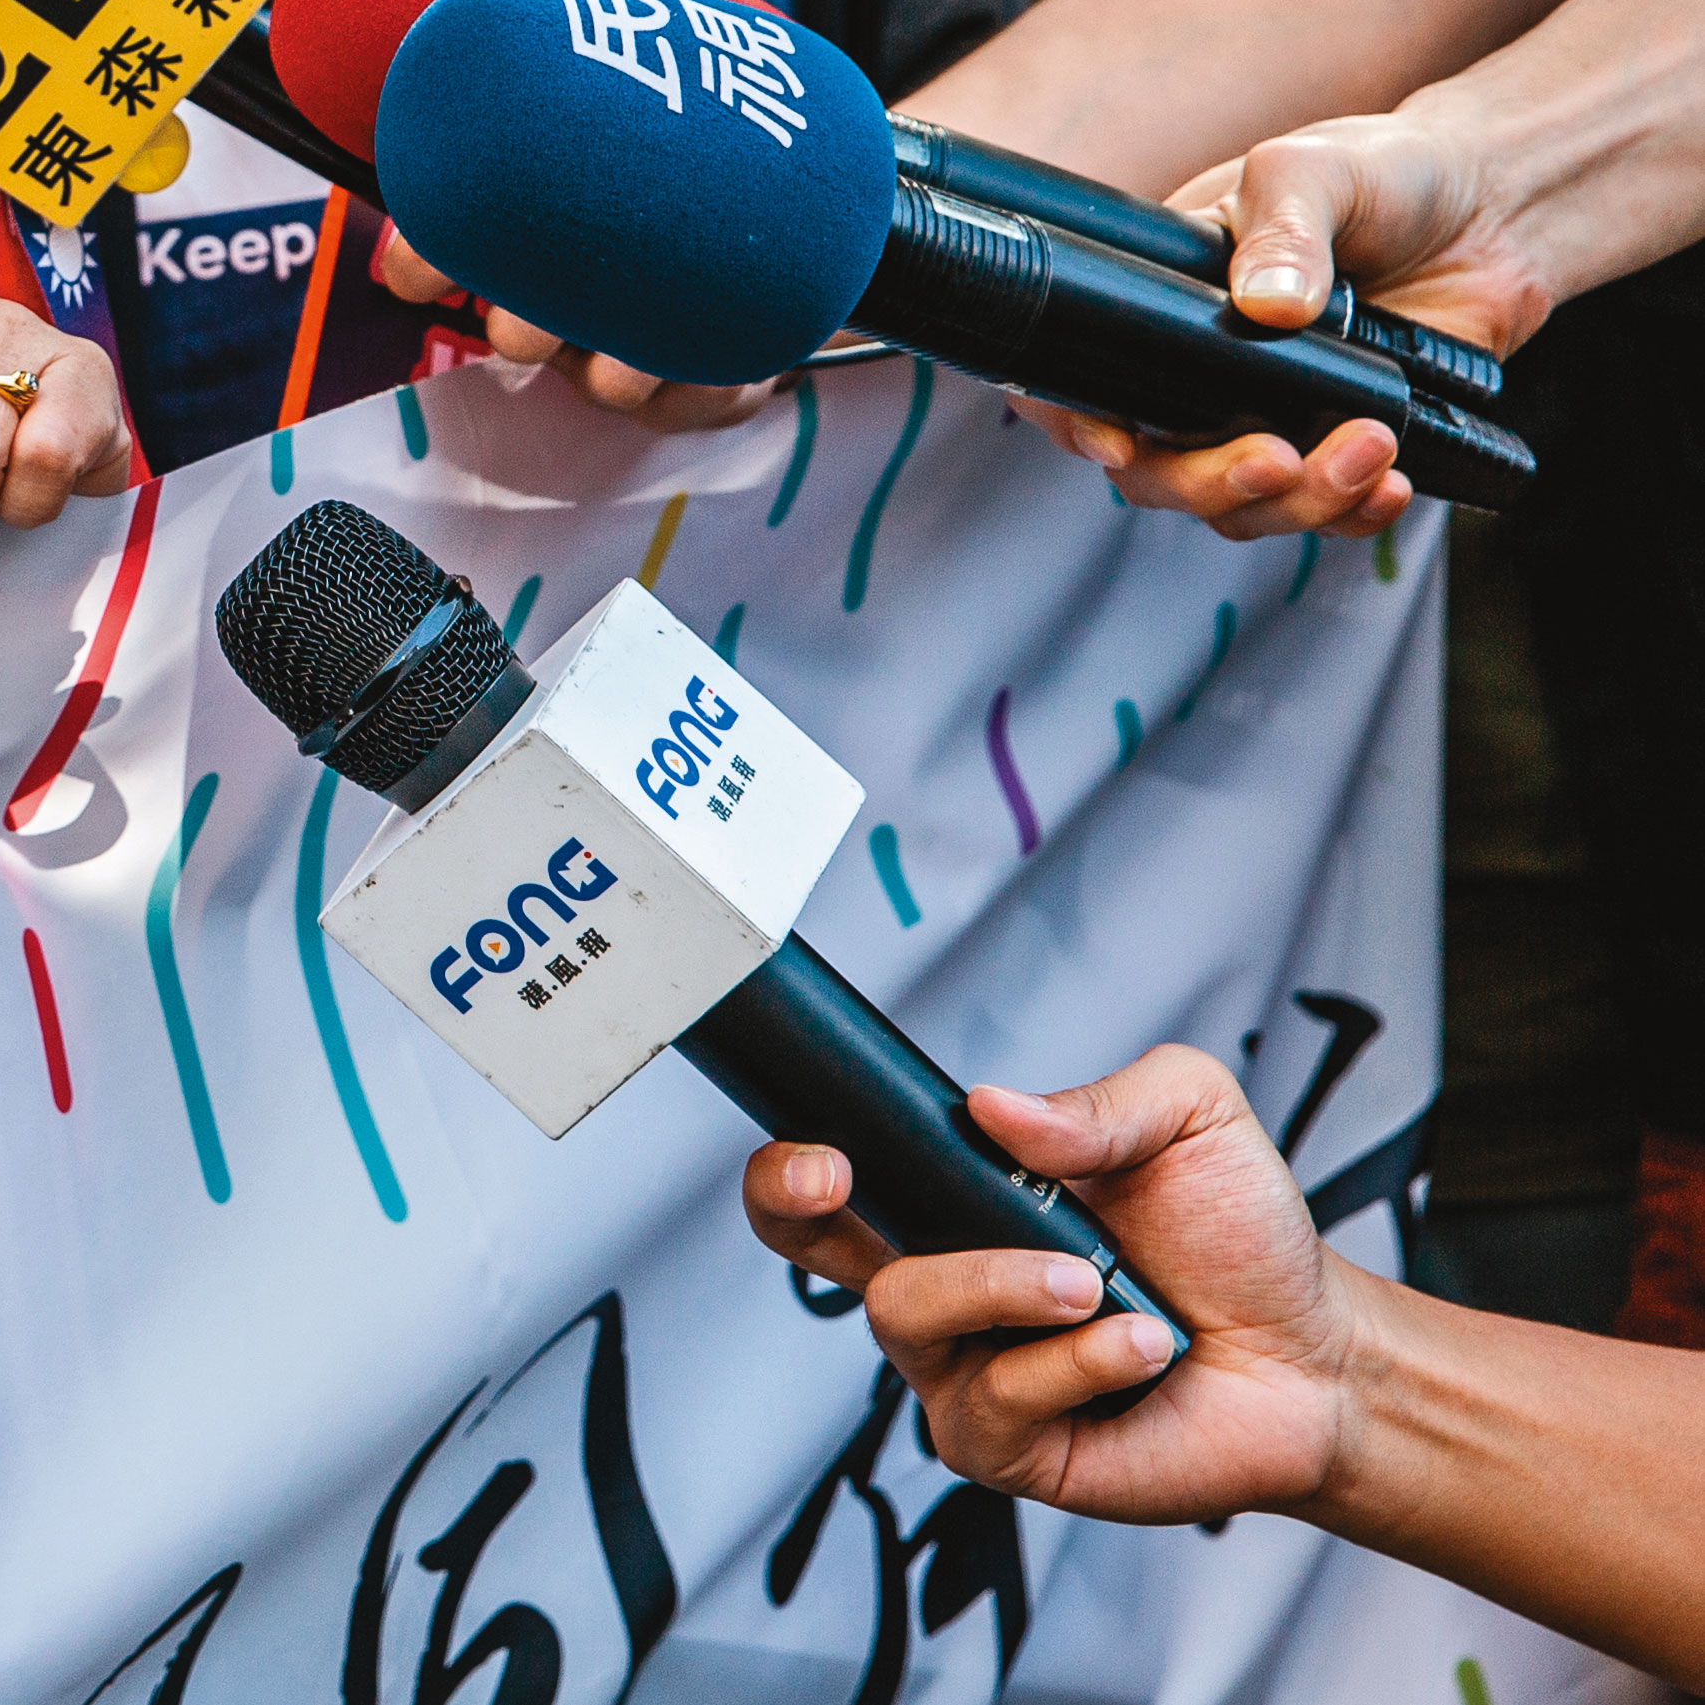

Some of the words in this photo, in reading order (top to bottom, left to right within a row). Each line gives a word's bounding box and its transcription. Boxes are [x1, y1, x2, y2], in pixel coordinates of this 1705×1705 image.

[137, 220, 318, 286] Keep
[636, 674, 739, 821] FONG
[430, 836, 619, 1015] FONG
